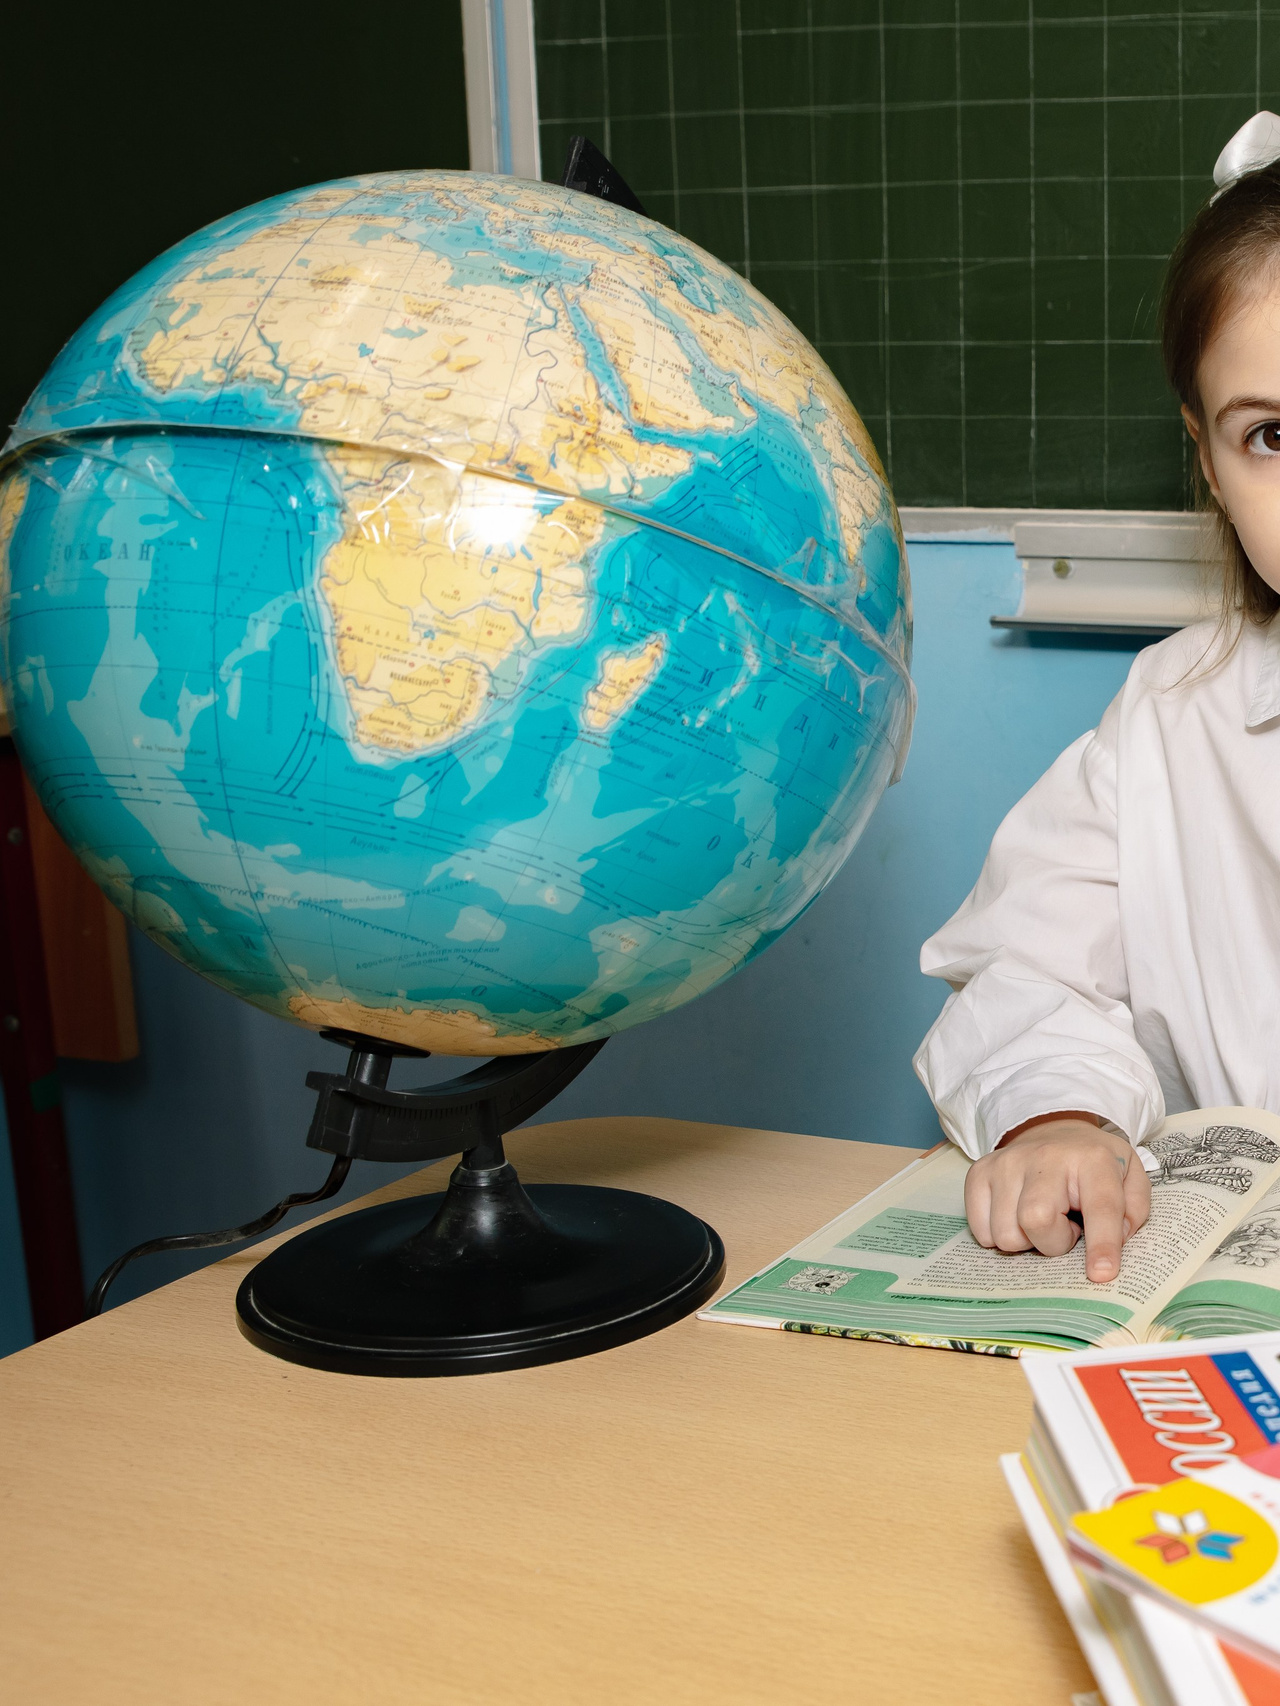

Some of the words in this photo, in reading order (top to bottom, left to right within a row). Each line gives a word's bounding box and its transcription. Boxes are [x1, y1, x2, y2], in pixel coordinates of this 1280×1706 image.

[64, 541, 152, 563] ОКЕАН
[1121, 1274, 1157, 1291] Весной,
[1116, 1289, 1145, 1305] саман,
[1117, 1285, 1150, 1301] дерево
[1118, 1367, 1239, 1477] ОССИИ
